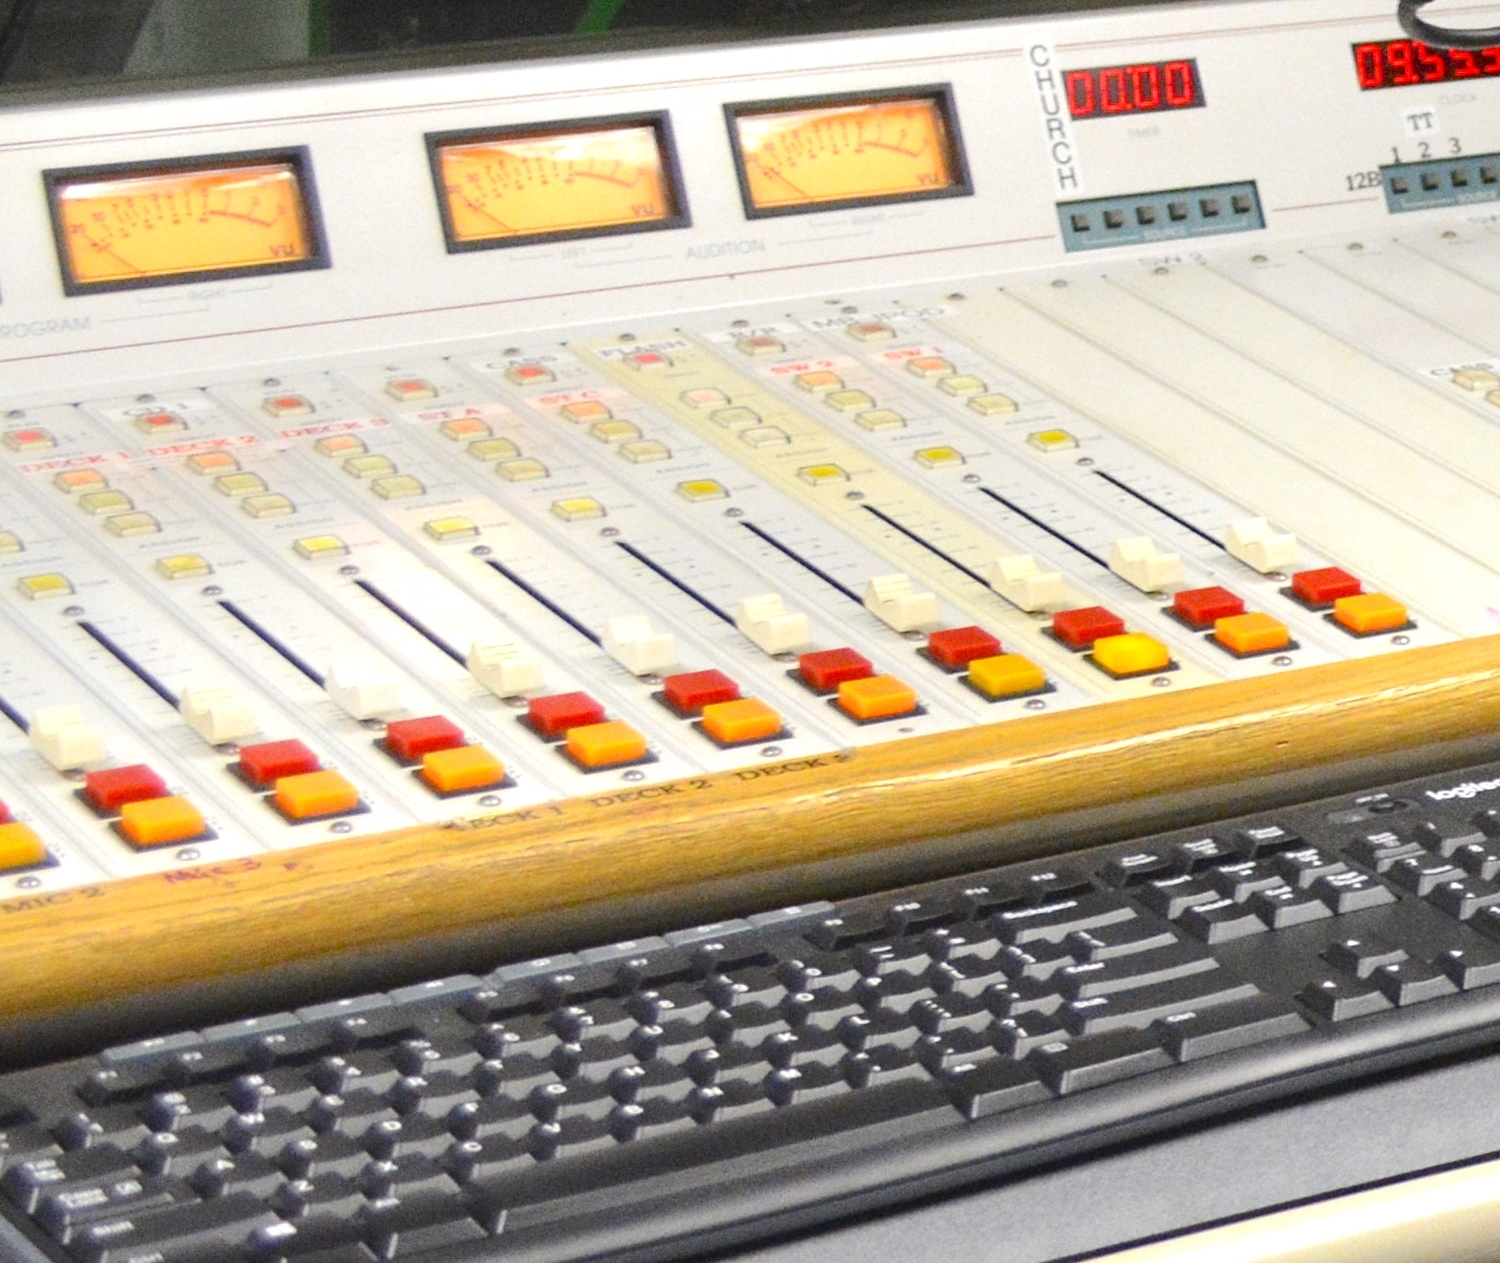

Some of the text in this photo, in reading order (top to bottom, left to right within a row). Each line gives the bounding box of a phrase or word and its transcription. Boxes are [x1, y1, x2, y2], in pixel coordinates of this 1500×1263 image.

[1028, 43, 1078, 191] CHURCH
[1406, 112, 1435, 132] TT
[1392, 136, 1463, 165] 1 2 3
[270, 244, 296, 257] VU
[685, 237, 767, 260] AUDITION
[279, 421, 364, 439] DECK
[147, 433, 260, 457] DECK 2
[20, 454, 108, 474] DECK
[733, 757, 830, 782] DECK
[590, 778, 715, 809] DECK 2
